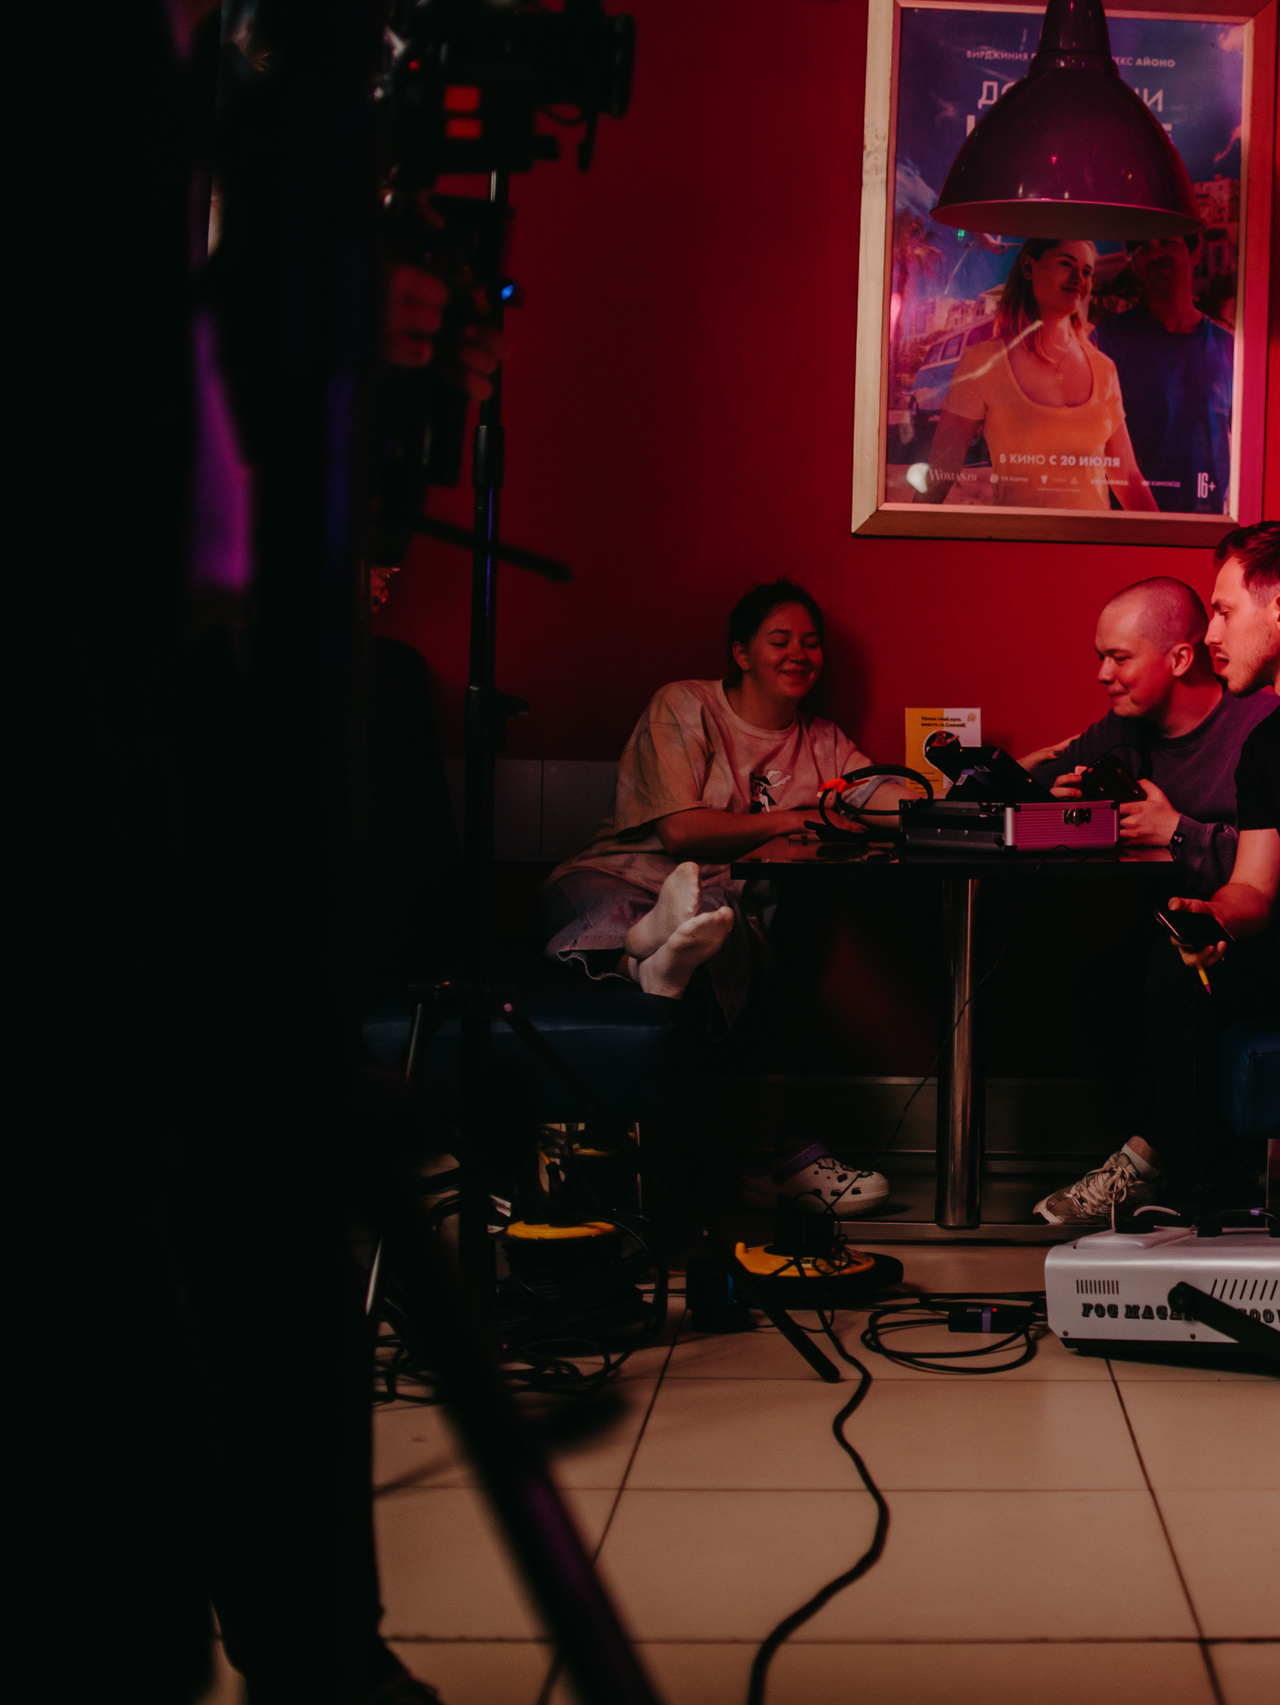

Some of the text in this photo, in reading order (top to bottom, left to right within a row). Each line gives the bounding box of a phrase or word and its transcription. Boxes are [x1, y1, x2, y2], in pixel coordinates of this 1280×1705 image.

[966, 50, 1028, 61] ВИРДЖИНИЯ
[1135, 56, 1176, 68] АЙОНО
[1000, 453, 1121, 468] В КИНО С 20 ИЮЛЯ
[1197, 472, 1217, 499] 16+
[1081, 1302, 1119, 1319] FOG
